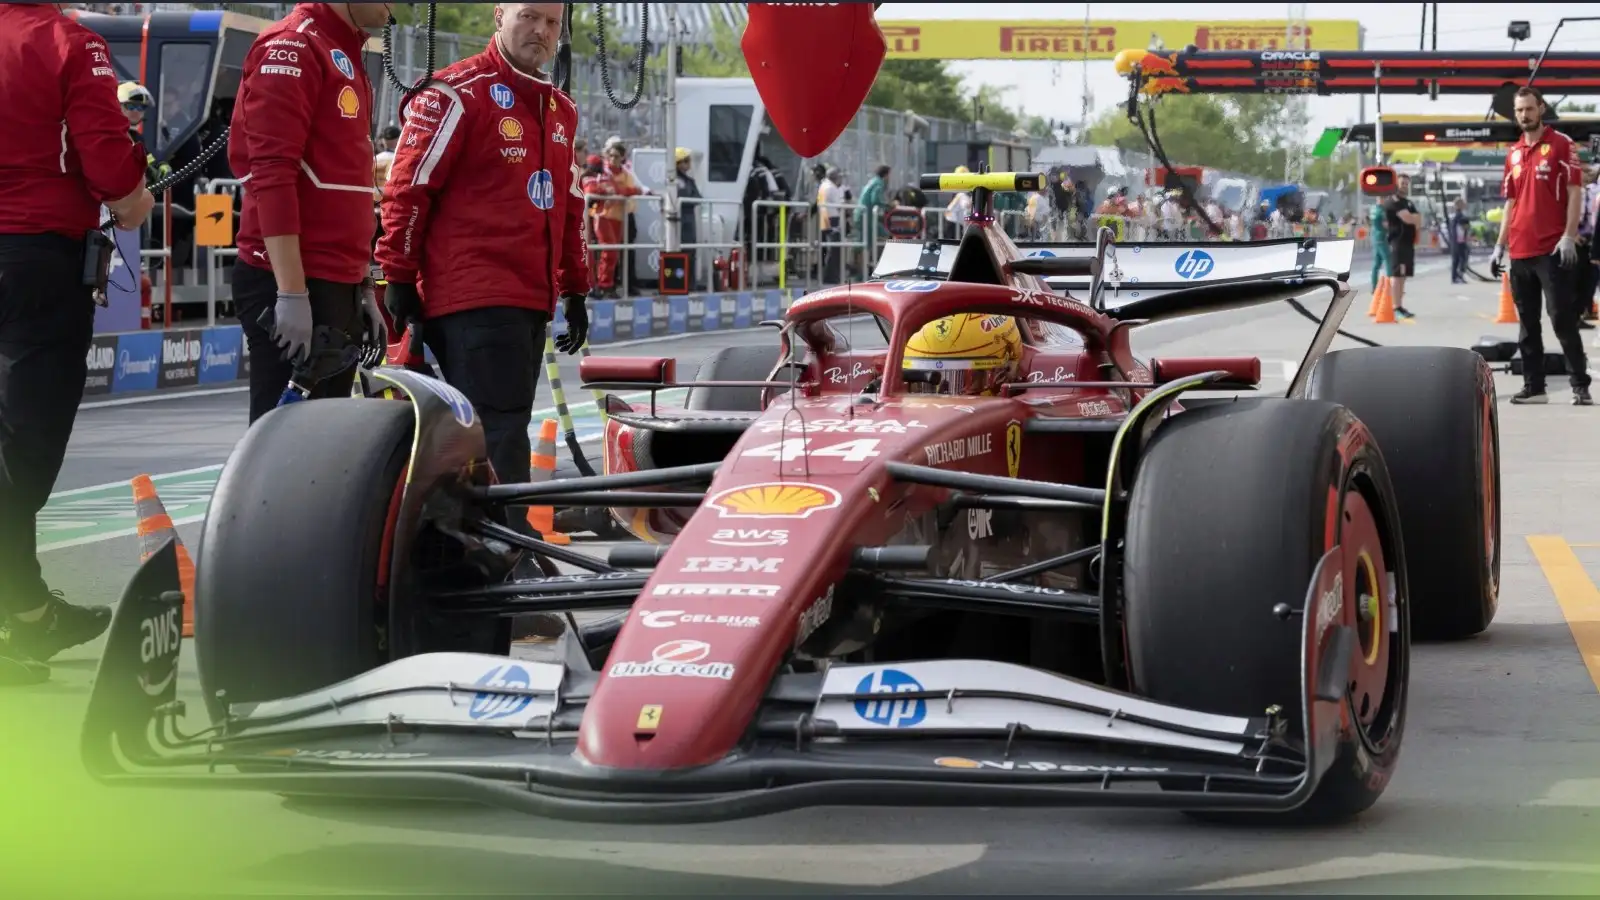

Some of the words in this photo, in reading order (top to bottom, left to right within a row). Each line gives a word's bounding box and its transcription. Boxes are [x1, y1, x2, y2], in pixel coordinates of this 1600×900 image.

[1000, 26, 1116, 52] PIRELLI
[268, 49, 298, 62] ZCG
[1261, 52, 1320, 60] ORACLE
[261, 65, 302, 77] PIRELLI
[494, 83, 512, 109] hp
[500, 147, 527, 157] VGW
[1179, 250, 1209, 279] hp
[824, 361, 873, 383] Ray-Ban
[742, 438, 881, 461] 44
[924, 439, 965, 466] RICHARD
[967, 432, 992, 457] MILLE
[712, 529, 789, 539] aws
[680, 557, 785, 573] IBM
[680, 614, 760, 625] CELSIUS
[141, 607, 179, 663] aws
[610, 661, 733, 679] UniCredit
[472, 665, 527, 720] hp
[864, 669, 919, 728] hp
[981, 760, 1169, 772] V-Power
